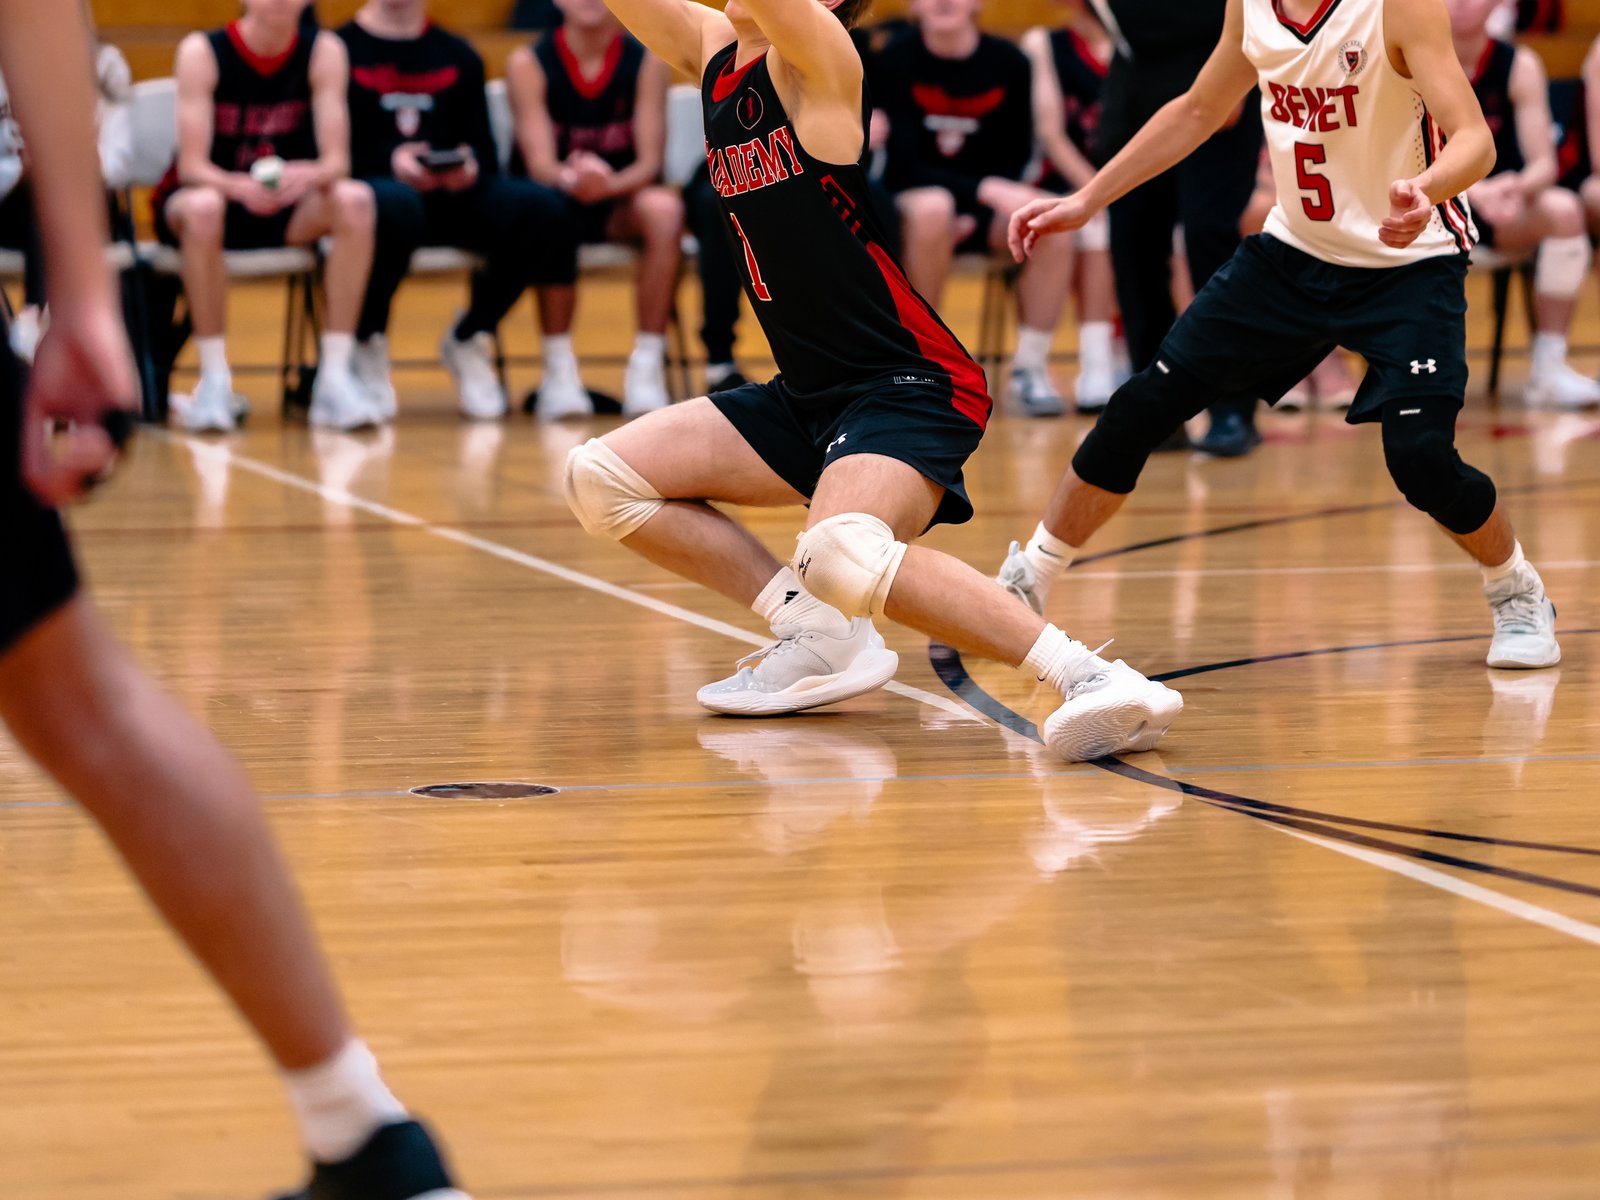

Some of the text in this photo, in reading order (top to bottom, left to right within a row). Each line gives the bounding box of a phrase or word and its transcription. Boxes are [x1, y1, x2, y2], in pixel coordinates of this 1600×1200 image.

[1268, 81, 1359, 132] BENET
[1294, 141, 1335, 221] 5
[729, 212, 772, 301] 1
